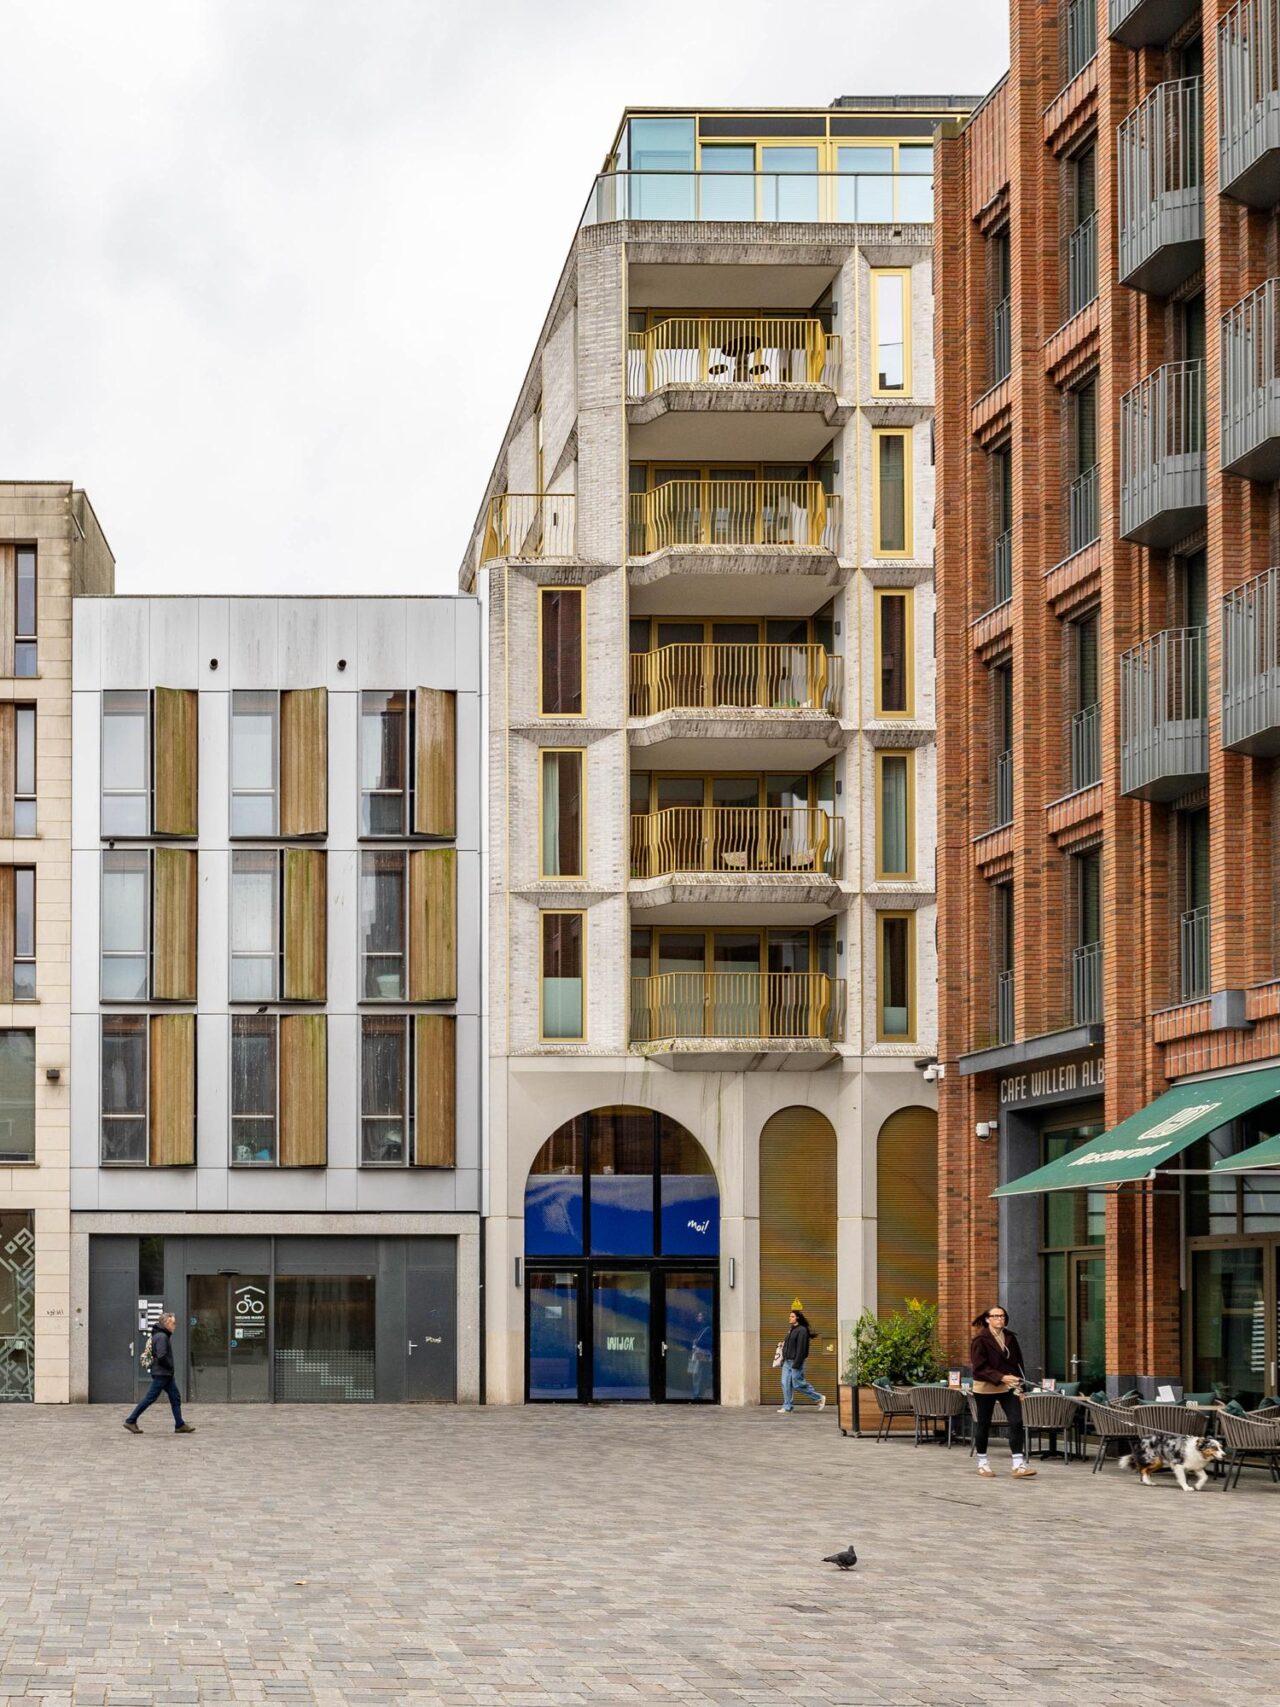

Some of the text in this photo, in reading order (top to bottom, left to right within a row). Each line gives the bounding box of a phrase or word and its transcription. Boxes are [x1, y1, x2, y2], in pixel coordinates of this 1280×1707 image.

[1000, 1075, 1027, 1104] CAFE
[1031, 1064, 1077, 1097] WILLEM
[687, 1219, 709, 1234] moi!
